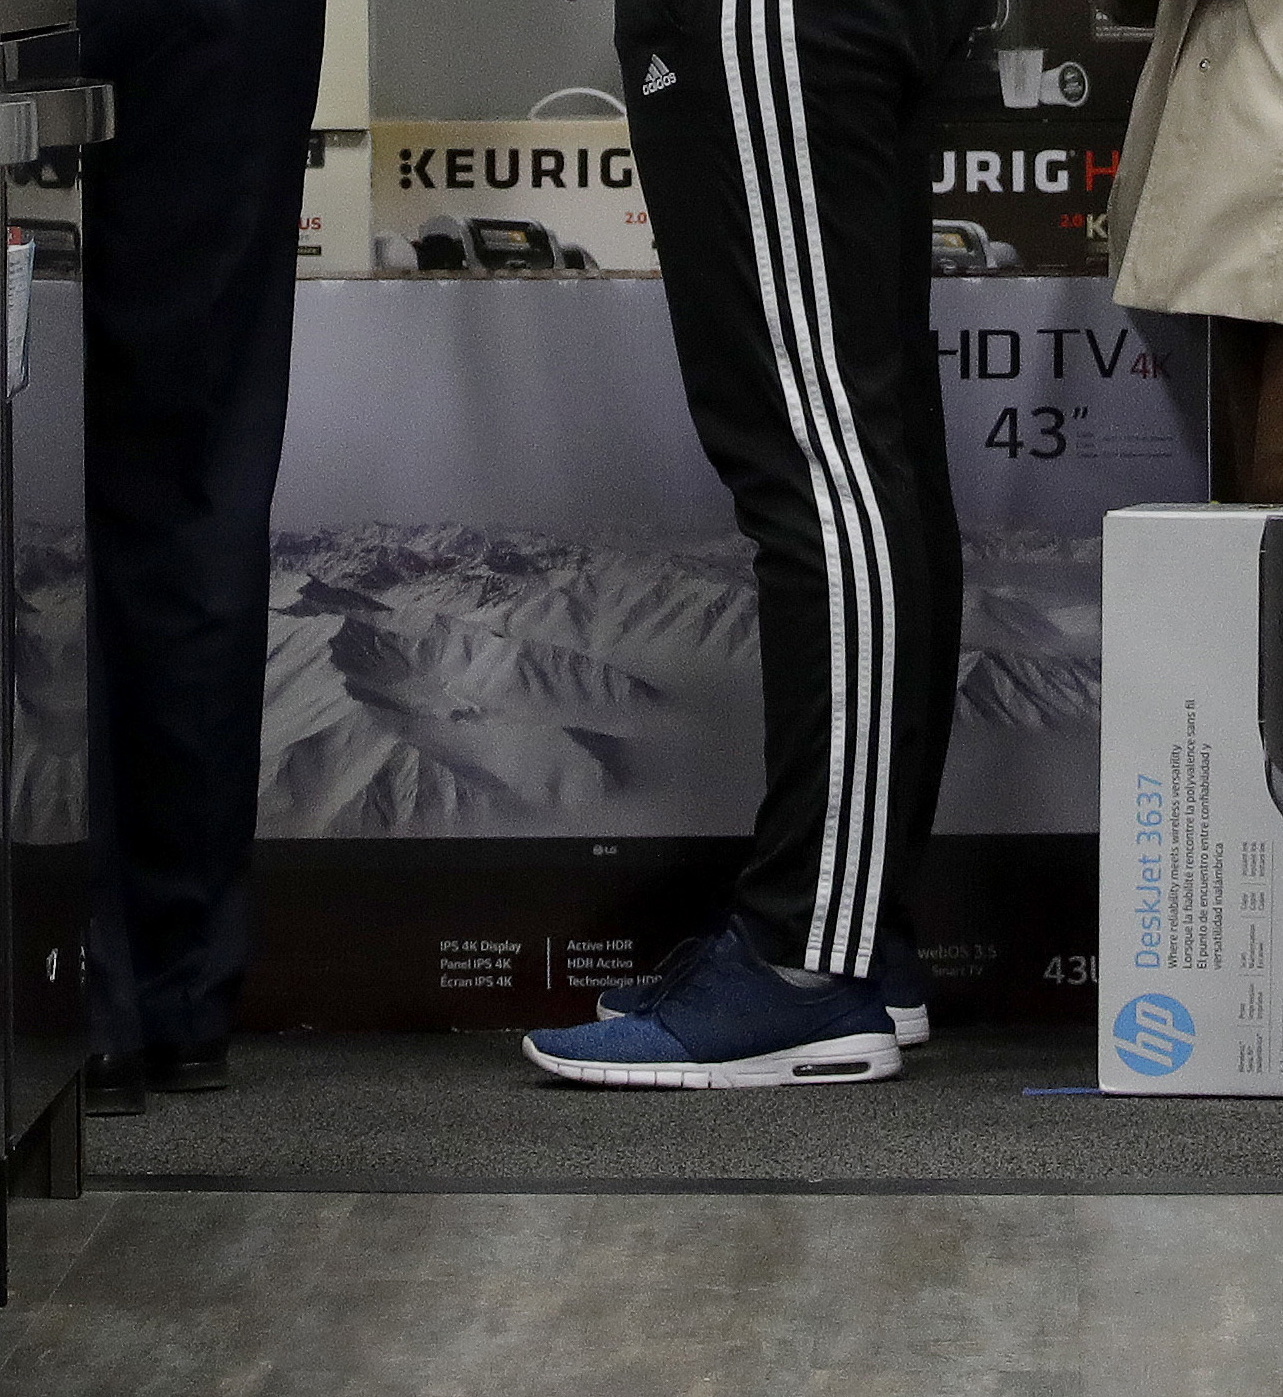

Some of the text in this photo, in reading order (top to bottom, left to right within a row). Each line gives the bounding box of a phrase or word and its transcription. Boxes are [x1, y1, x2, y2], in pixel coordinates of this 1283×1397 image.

[643, 72, 677, 96] adidas
[399, 147, 632, 190] KEURIG
[625, 211, 648, 225] 2.0
[1037, 329, 1128, 379] TV
[1131, 352, 1171, 379] 4K
[1185, 699, 1195, 710] fil
[1186, 712, 1196, 737] sans
[1202, 743, 1212, 751] y
[1185, 739, 1197, 803] polyvalence
[1184, 805, 1195, 815] la
[1185, 818, 1195, 870] rencontre
[1200, 822, 1209, 851] entre
[1168, 744, 1182, 969] Where reliability meets wireless versatility
[1134, 774, 1163, 969] DeskJet 3637
[1198, 853, 1209, 908] encuentro
[1212, 842, 1224, 970] versatilidad inalámbrica
[1182, 914, 1193, 924] la
[1198, 910, 1208, 923] de
[440, 940, 522, 954] IPS 4K Display
[567, 940, 633, 951] Active HDR
[1182, 926, 1195, 969] Lorsque
[1198, 926, 1210, 957] punto
[917, 944, 998, 960] webOS 3.5
[440, 958, 512, 970] Panel IPS 4K
[567, 957, 633, 969] HDR Activo
[1197, 959, 1208, 969] El
[440, 973, 512, 987] Écran IPS 4K
[567, 975, 633, 989] Technologie
[1114, 998, 1195, 1070] hp
